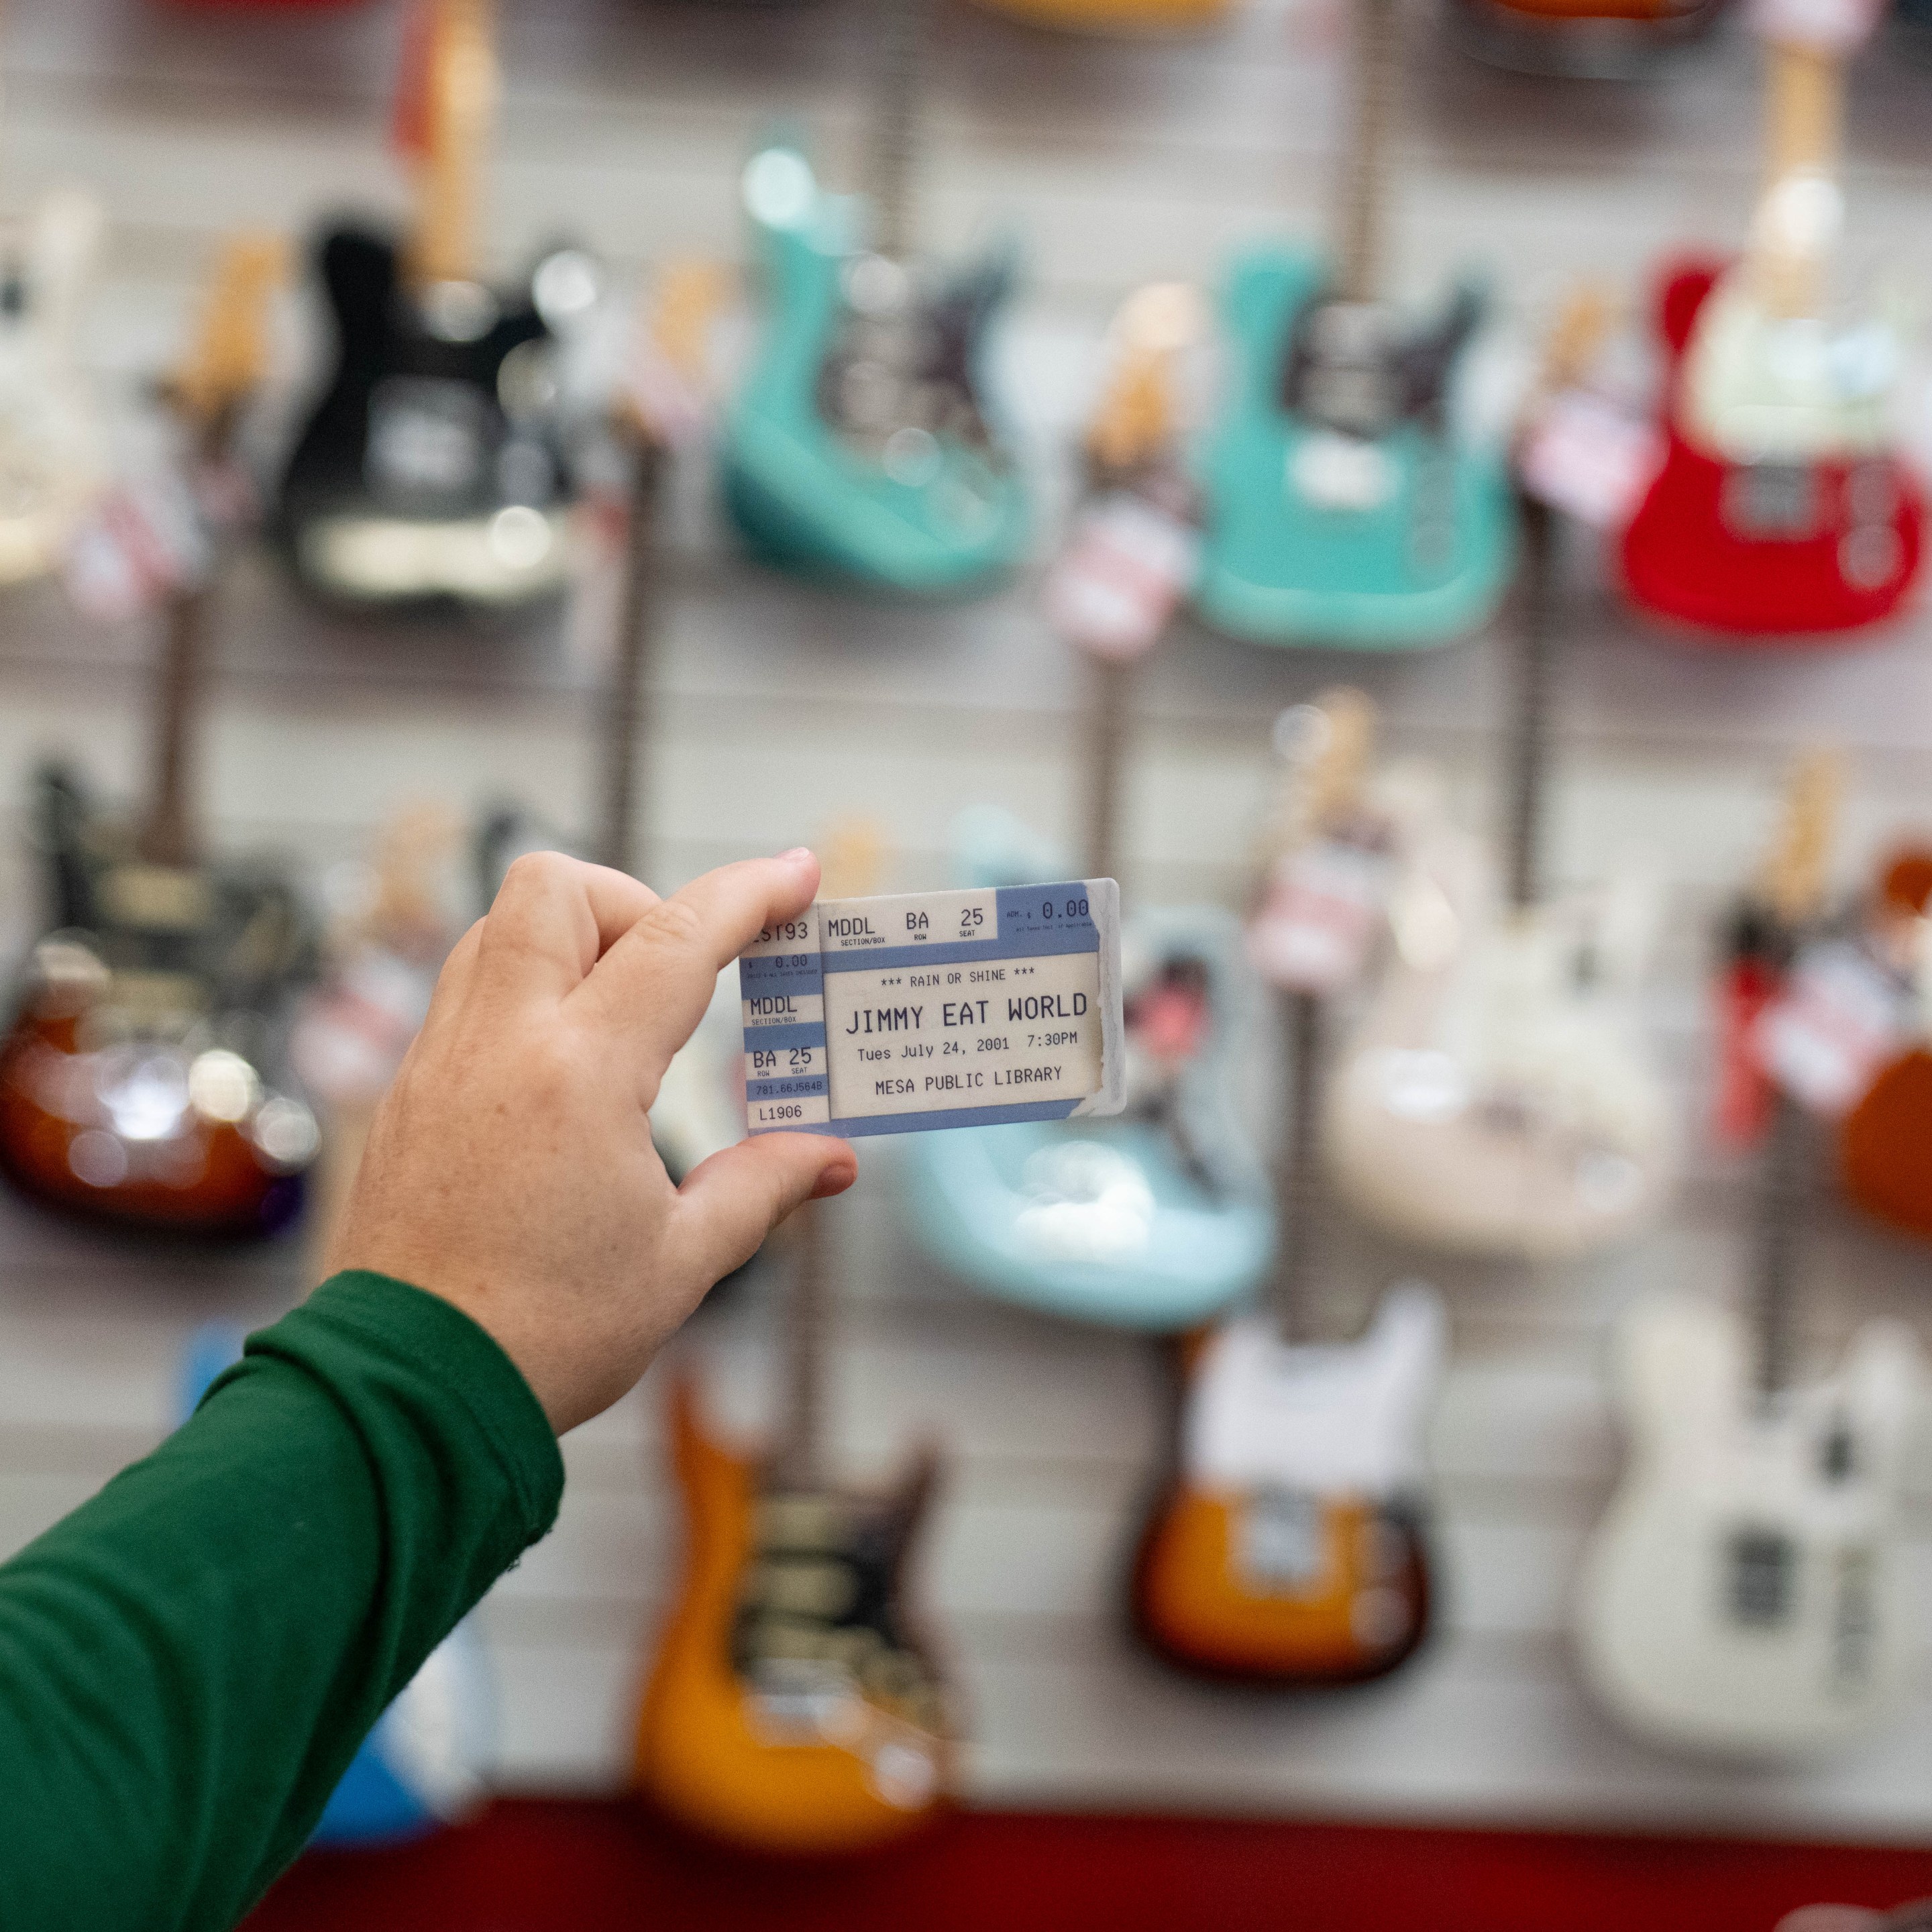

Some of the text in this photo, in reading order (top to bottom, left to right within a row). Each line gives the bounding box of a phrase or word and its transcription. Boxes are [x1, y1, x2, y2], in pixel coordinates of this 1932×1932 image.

[1042, 899, 1088, 919] 0.00
[753, 922, 808, 943] ST93
[828, 908, 983, 938] MDDL BA 25
[841, 935, 885, 946] SECTION/BOX
[775, 955, 808, 968] 0.00
[910, 975, 939, 987] RAIN
[947, 973, 961, 984] OR
[970, 969, 1005, 982] SHINE
[751, 996, 797, 1015] MDDL
[846, 993, 1087, 1034] JIMMY EAT WORLD
[751, 1015, 798, 1026] SECTION/BOX
[858, 1032, 1077, 1061] Tues July 24, 2001 7:30PM
[753, 1047, 811, 1068] BA 25
[757, 1081, 822, 1095] 781.66J564B
[875, 1067, 1061, 1095] MESA PUBLIC LIBRARY
[759, 1105, 802, 1120] L1906
